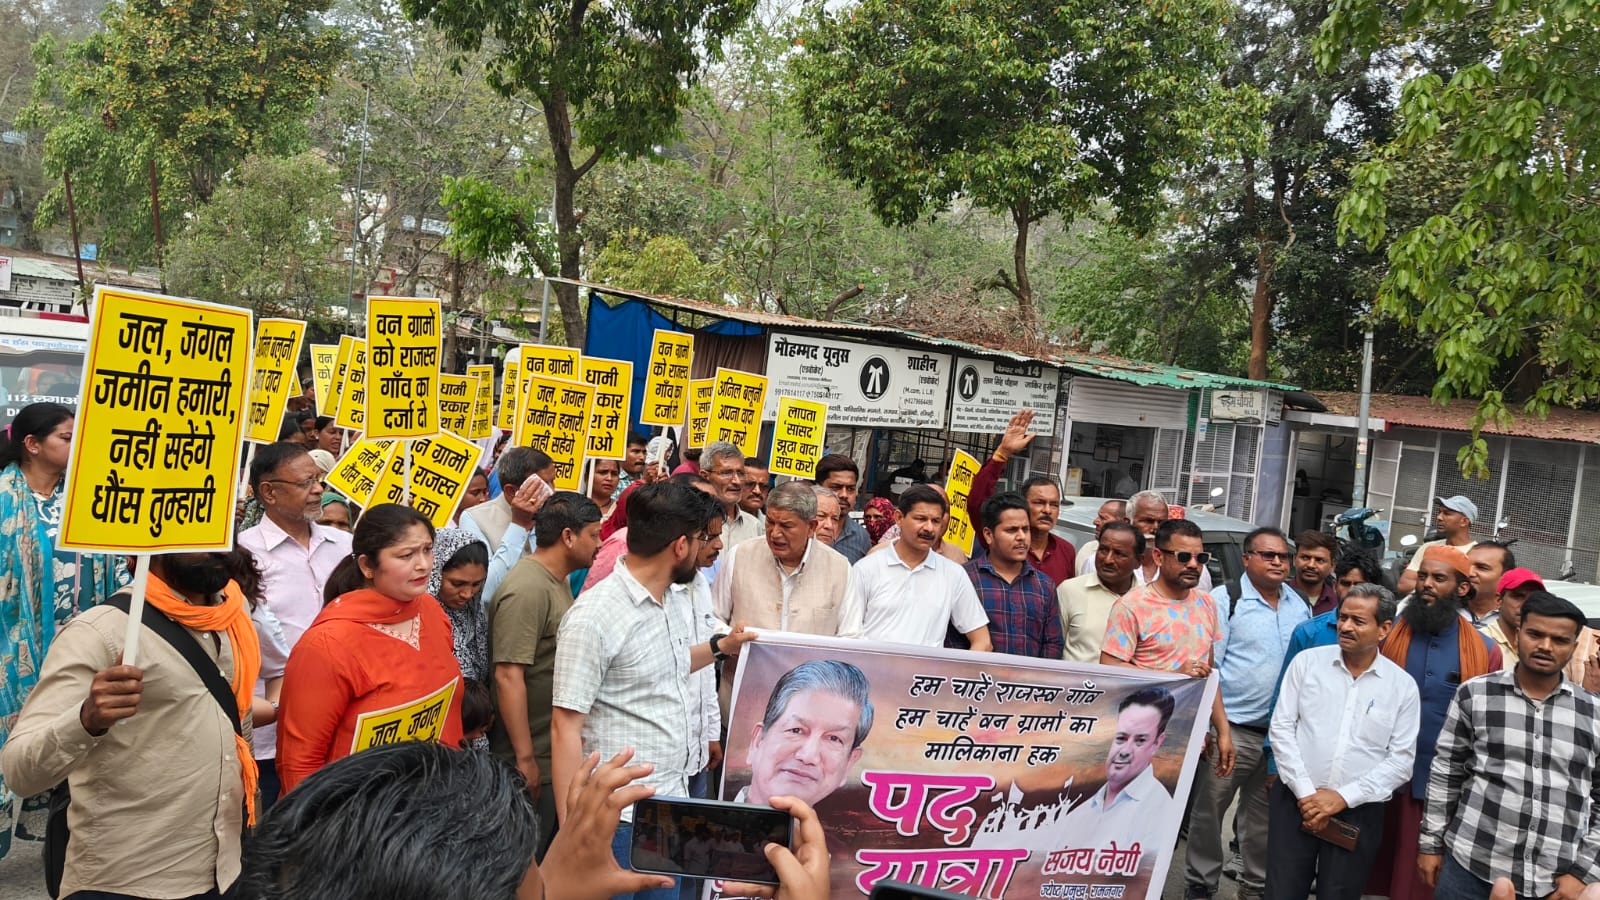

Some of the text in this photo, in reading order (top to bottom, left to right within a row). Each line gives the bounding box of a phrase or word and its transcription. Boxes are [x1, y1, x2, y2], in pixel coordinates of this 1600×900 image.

[377, 308, 435, 338] वन ग्रामों
[118, 312, 235, 364] जल, जंगल
[270, 330, 296, 368] बलूनी
[657, 340, 673, 357] वन
[373, 339, 437, 368] को राजस्व
[526, 355, 574, 375] वन ग्रामों
[774, 336, 938, 372] मौहम्मद यूनुस शाहीन
[586, 366, 619, 387] धामी
[653, 358, 667, 378] को
[1027, 366, 1040, 376] 14
[94, 359, 173, 413] जमीन
[176, 368, 235, 424] हमारी,
[265, 369, 283, 393] वादा
[381, 370, 429, 398] गाँव का
[440, 380, 467, 397] धामी
[655, 379, 683, 399] गाँव का
[697, 386, 713, 399] लाप
[717, 380, 743, 400] अनिल
[742, 382, 763, 407] बलूनी
[439, 400, 471, 413] रकार
[537, 384, 557, 407] जल,
[561, 386, 586, 409] जंगल
[384, 400, 427, 430] दर्जा दो
[454, 414, 466, 430] में
[527, 404, 585, 436] जमीन हमारी,
[606, 410, 621, 431] में
[717, 404, 755, 427] अपना वादा
[787, 405, 817, 422] लापता
[109, 418, 215, 470] नहीं सहेंगे
[531, 430, 575, 455] नहीं सहेंगे
[732, 425, 747, 447] करो
[358, 448, 380, 469] नहीं
[432, 443, 471, 473] ग्रामों
[799, 441, 818, 457] वादा
[775, 455, 815, 474] सच करो
[413, 466, 460, 499] राजस्व
[91, 469, 216, 537] धौंस तुम्हारी
[416, 496, 440, 520] का
[910, 672, 1104, 704] हम चाहें राजस्व गाँव
[408, 699, 444, 735] जंगल
[896, 705, 1098, 734] हम चाहें वन ग्रामों का
[924, 735, 1060, 766] मालिकाना हक
[863, 772, 995, 844] पद
[1043, 840, 1142, 873] संजय नेगी
[1089, 884, 1125, 898] रामनगर
